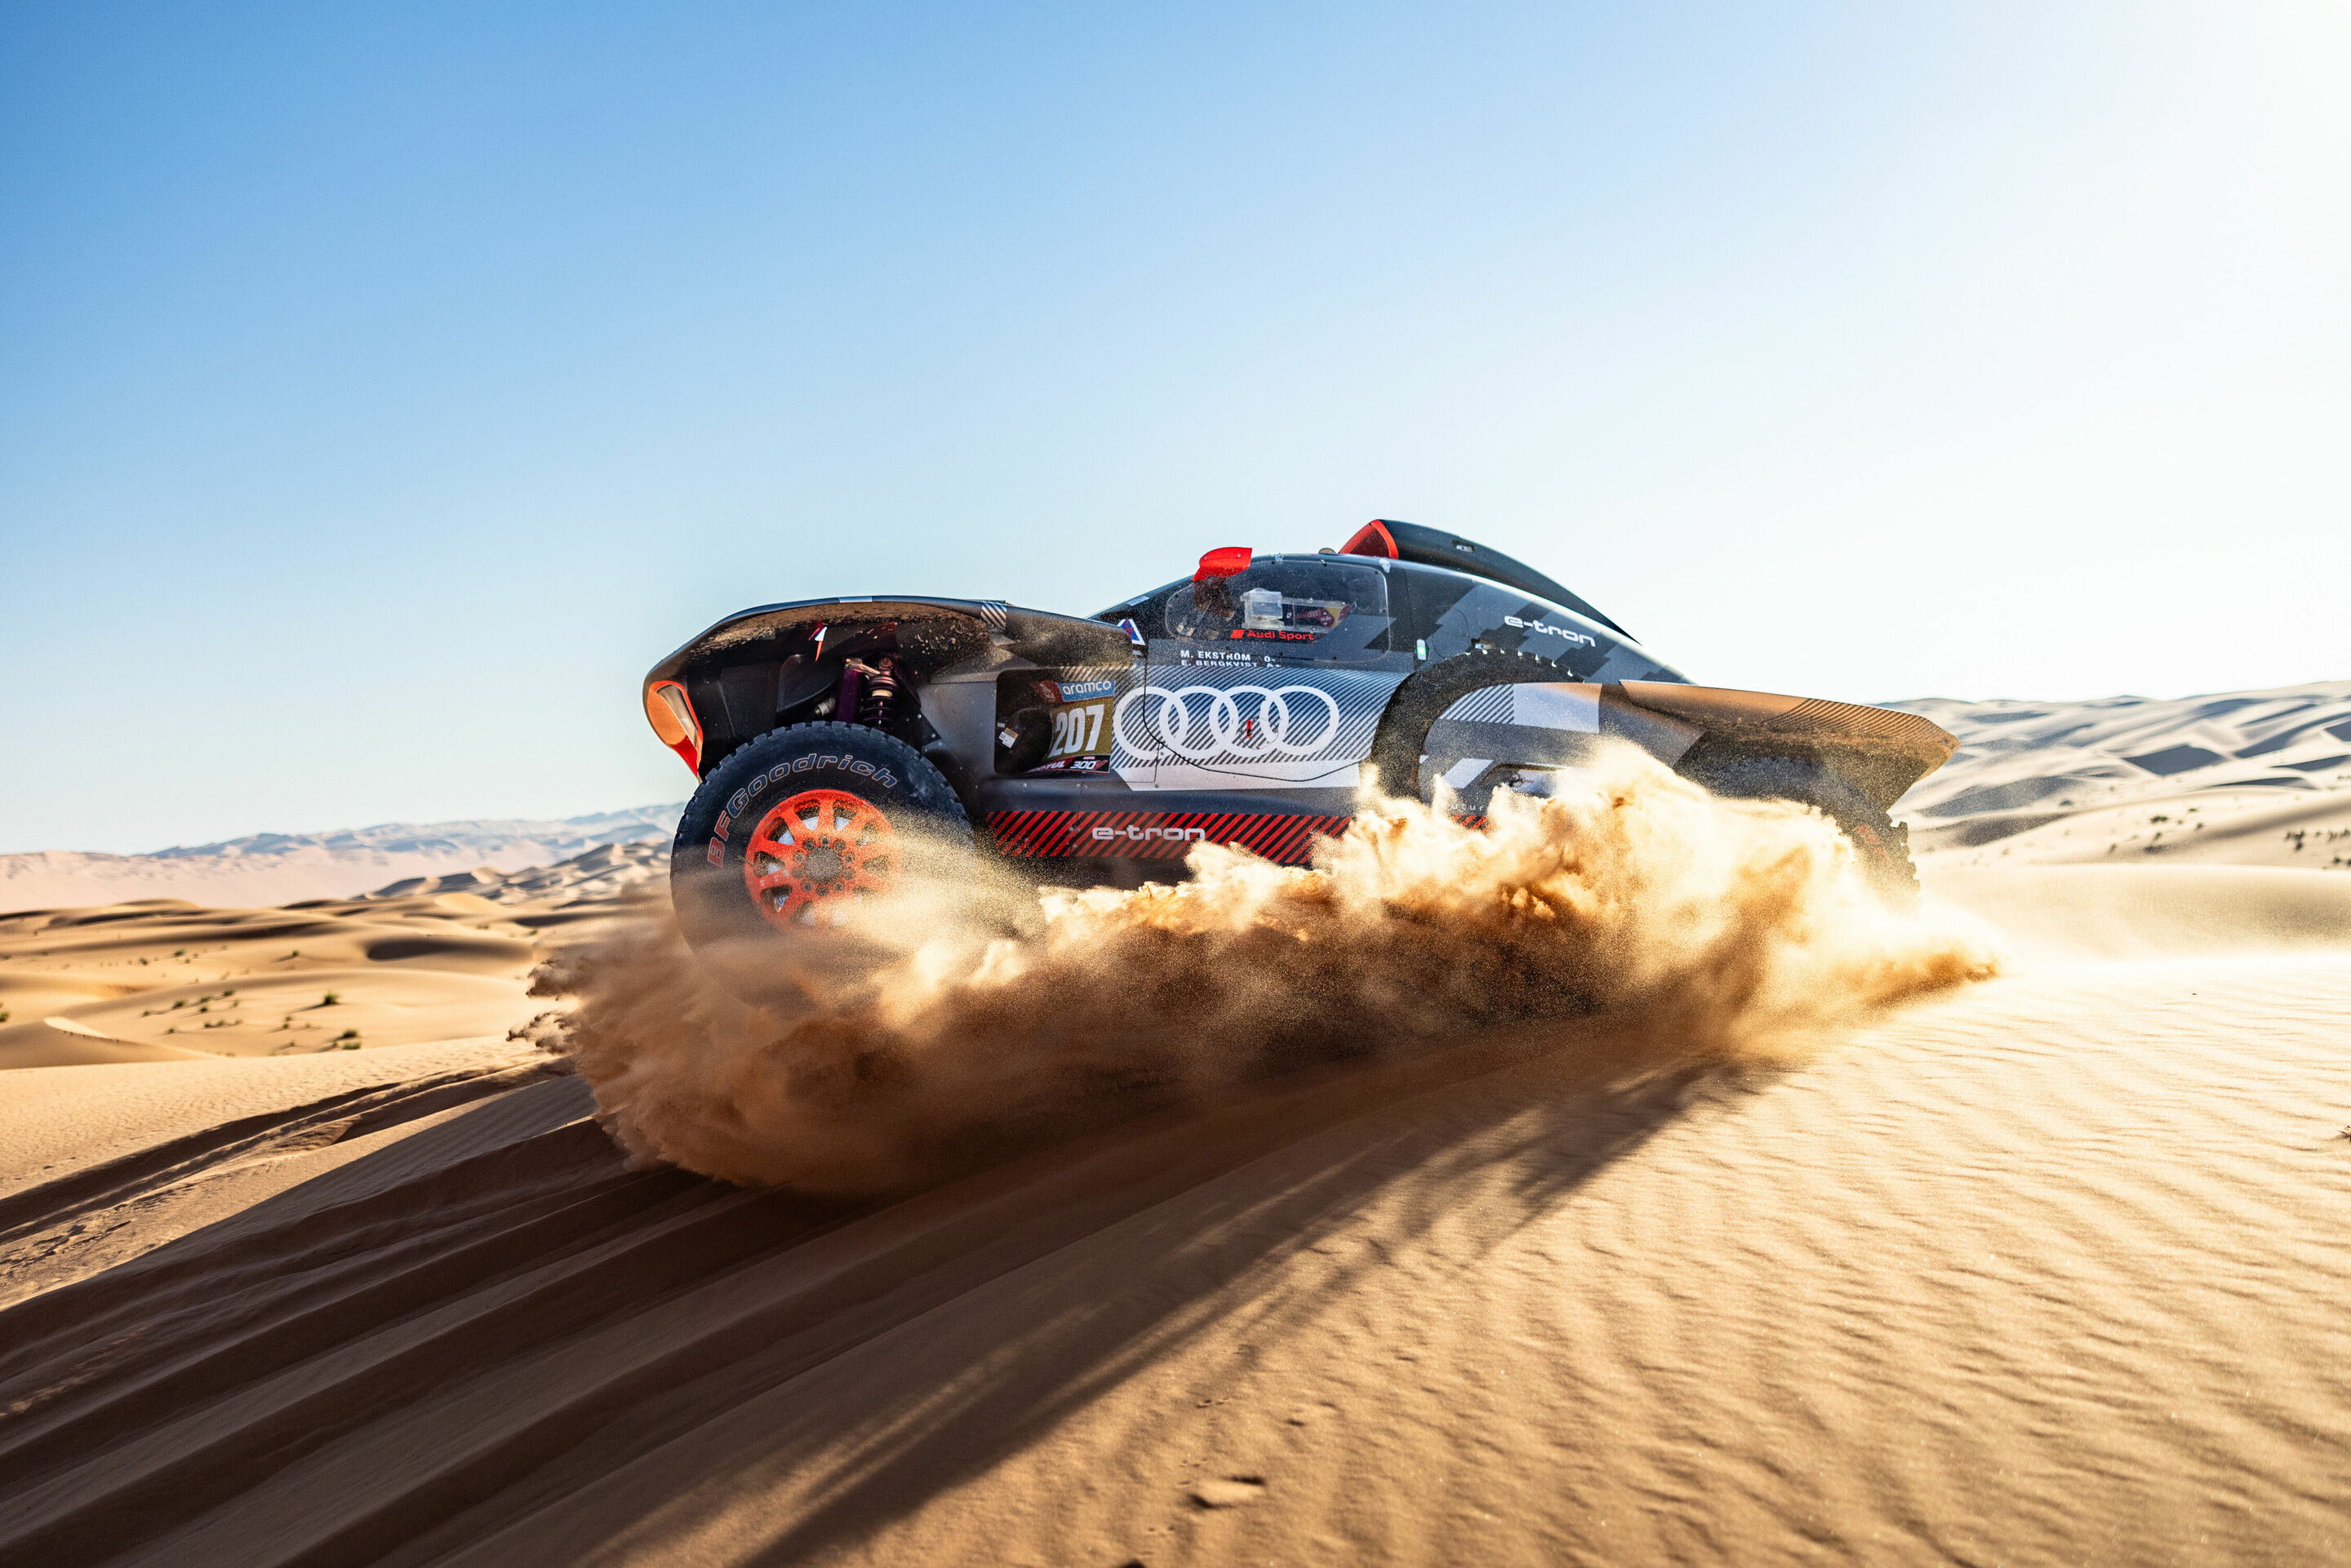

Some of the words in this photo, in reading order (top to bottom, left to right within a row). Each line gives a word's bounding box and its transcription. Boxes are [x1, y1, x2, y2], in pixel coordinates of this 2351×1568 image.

[1247, 630, 1275, 639] Audi
[1278, 631, 1314, 641] Sport
[1504, 615, 1596, 647] e-tron
[1180, 650, 1193, 659] M.
[1062, 681, 1112, 695] aramco
[1047, 704, 1104, 759] 207
[1069, 760, 1109, 771] 300V
[707, 753, 898, 868] BFGoodrich
[1091, 824, 1206, 842] e-tron
